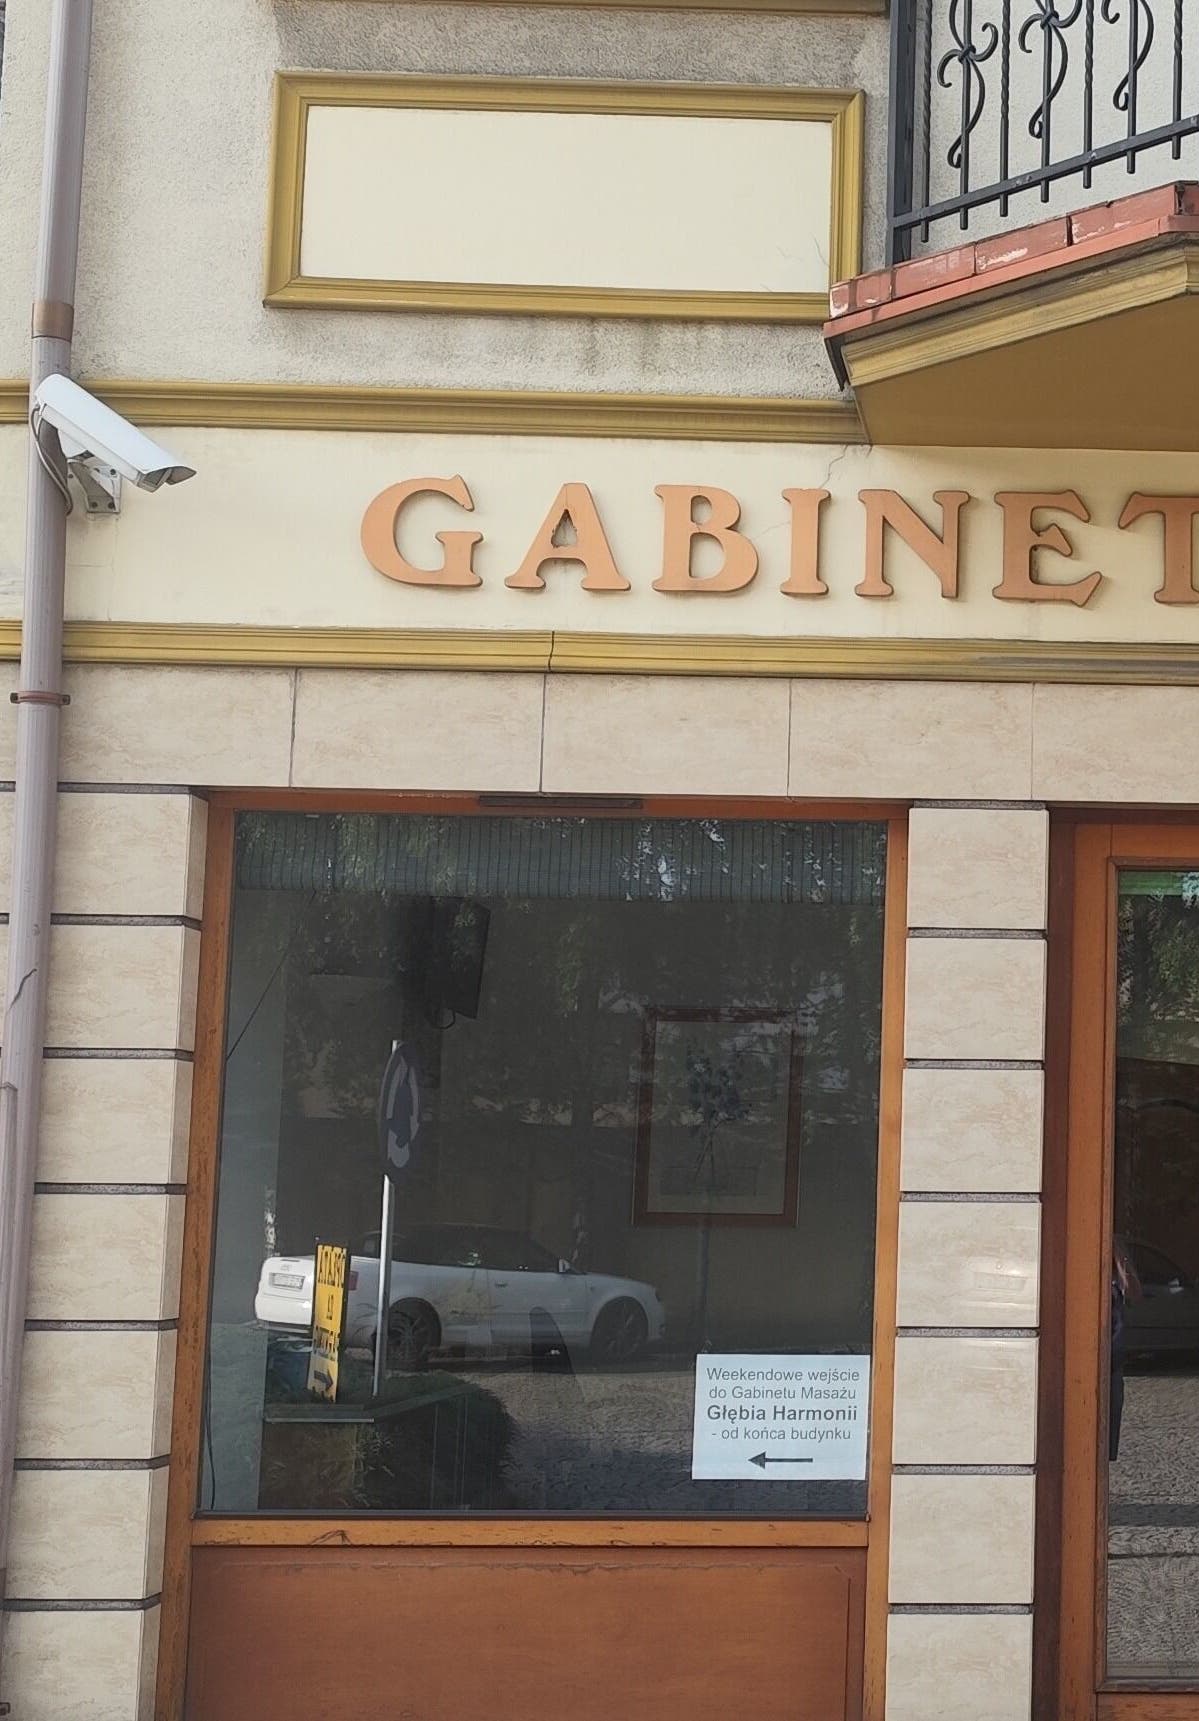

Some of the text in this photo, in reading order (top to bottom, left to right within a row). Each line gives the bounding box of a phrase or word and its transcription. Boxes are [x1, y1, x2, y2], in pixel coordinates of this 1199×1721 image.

[706, 1367, 860, 1384] Weekendowe wejście
[709, 1386, 857, 1400] do Gabinetu Masażu
[707, 1405, 858, 1424] Głębia Harmonii
[721, 1427, 739, 1439] od
[744, 1427, 785, 1440] końca
[790, 1427, 851, 1443] budynku
